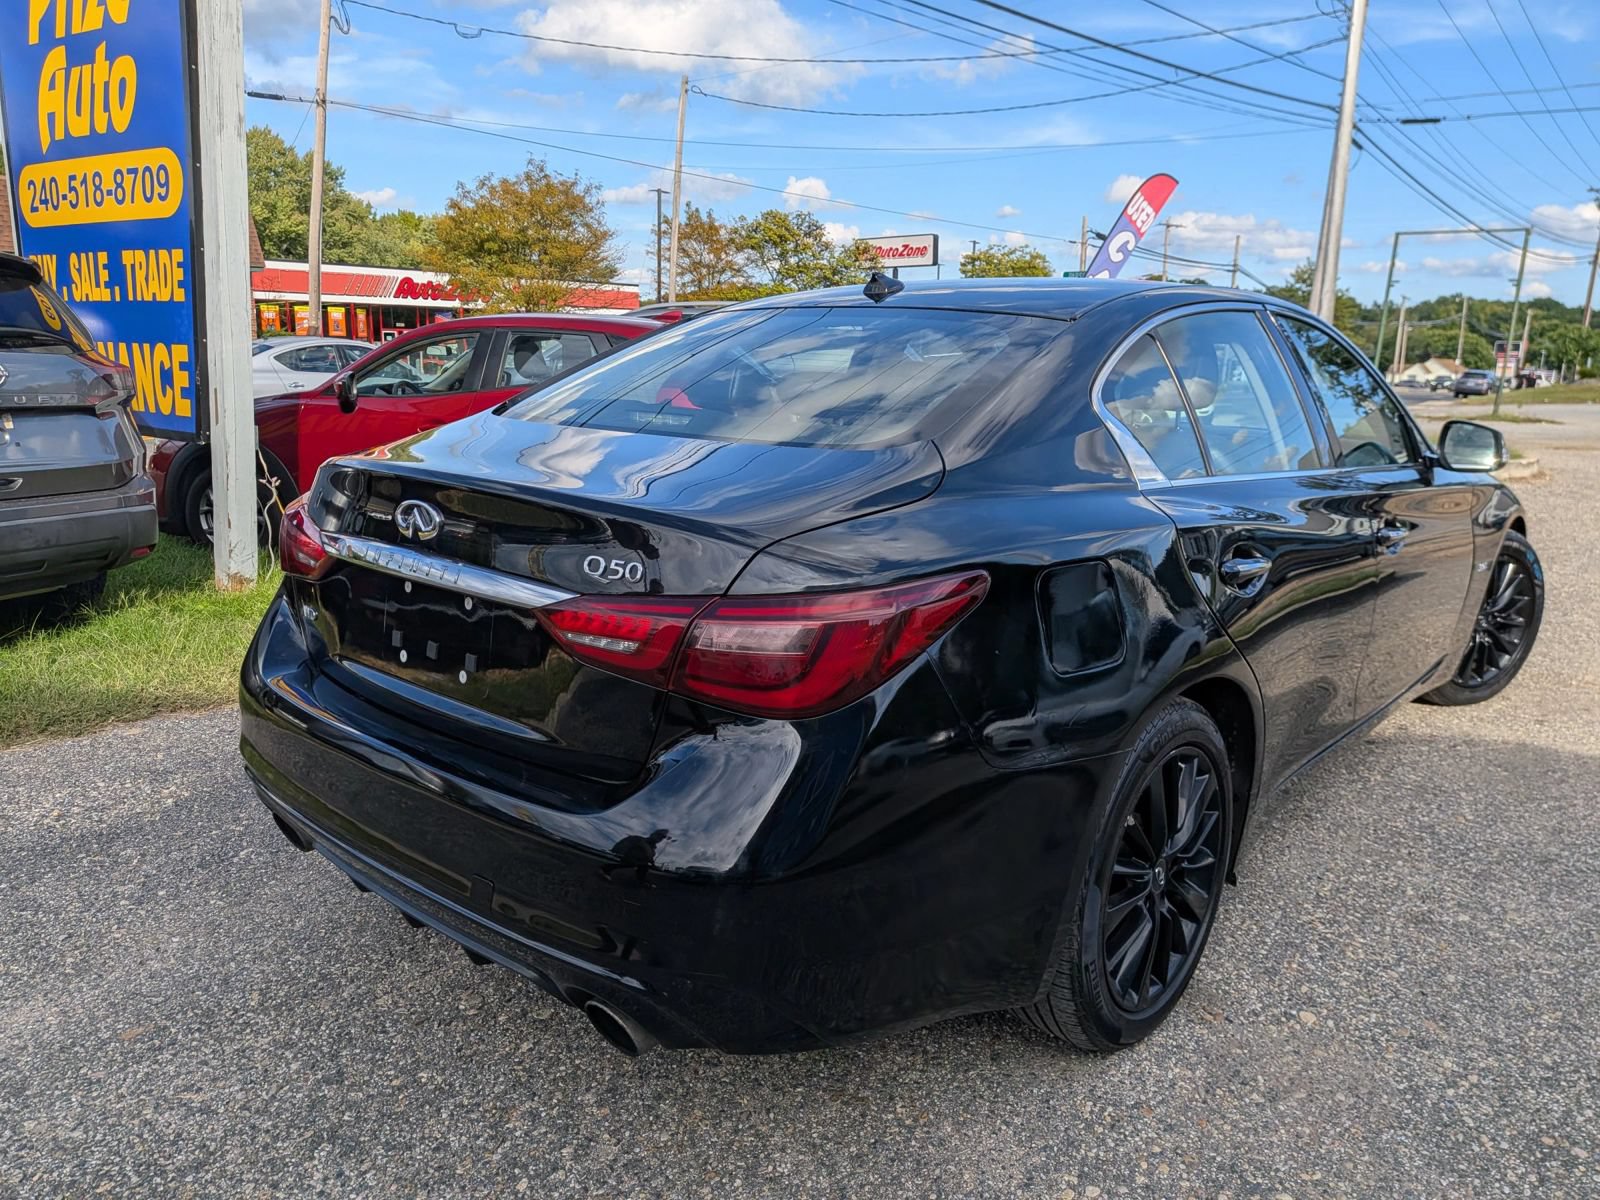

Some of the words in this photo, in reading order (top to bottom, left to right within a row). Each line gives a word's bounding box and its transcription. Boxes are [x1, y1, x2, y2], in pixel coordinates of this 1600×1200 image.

[38, 40, 137, 155] Auto
[28, 164, 170, 213] 240-518-8709
[1126, 191, 1156, 234] USED
[70, 252, 111, 301] SALE
[121, 249, 185, 302] TRADE
[583, 555, 643, 584] Q50
